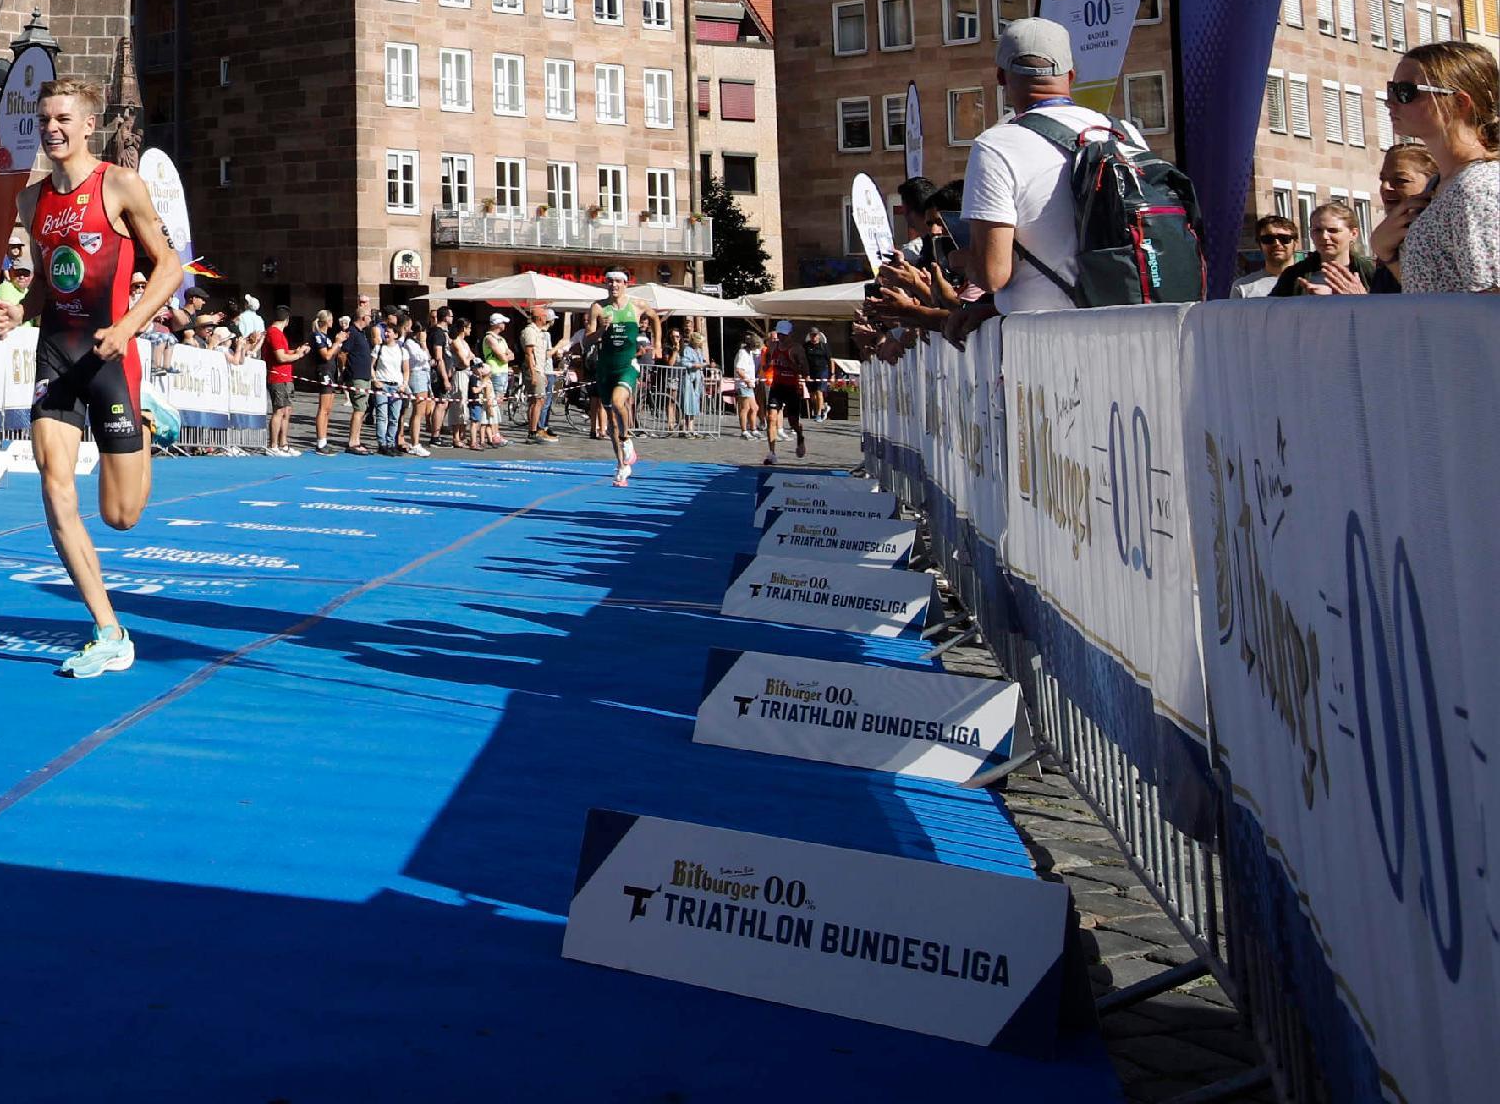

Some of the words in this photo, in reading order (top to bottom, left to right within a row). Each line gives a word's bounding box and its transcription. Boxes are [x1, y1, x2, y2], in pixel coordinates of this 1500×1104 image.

[19, 117, 33, 136] 0.0
[53, 262, 77, 276] EAM
[1108, 401, 1153, 580] 0.0
[789, 535, 838, 548] TRIATHLON
[839, 539, 897, 554] BUNDESLIGA
[770, 571, 809, 588] Bitburger
[809, 576, 828, 589] 0.0
[766, 585, 830, 605] TRIATHLON
[831, 594, 907, 615] BUNDESLIGA
[765, 678, 822, 702] Bitburger
[825, 686, 853, 705] 0.0
[760, 699, 857, 730] TRIATHLON
[861, 715, 981, 747] BUNDESLIGA
[670, 859, 761, 901] Bitburger
[763, 875, 807, 908] 0.0
[664, 892, 815, 949] TRIATHLON
[820, 923, 1010, 987] BUNDESLIGA
